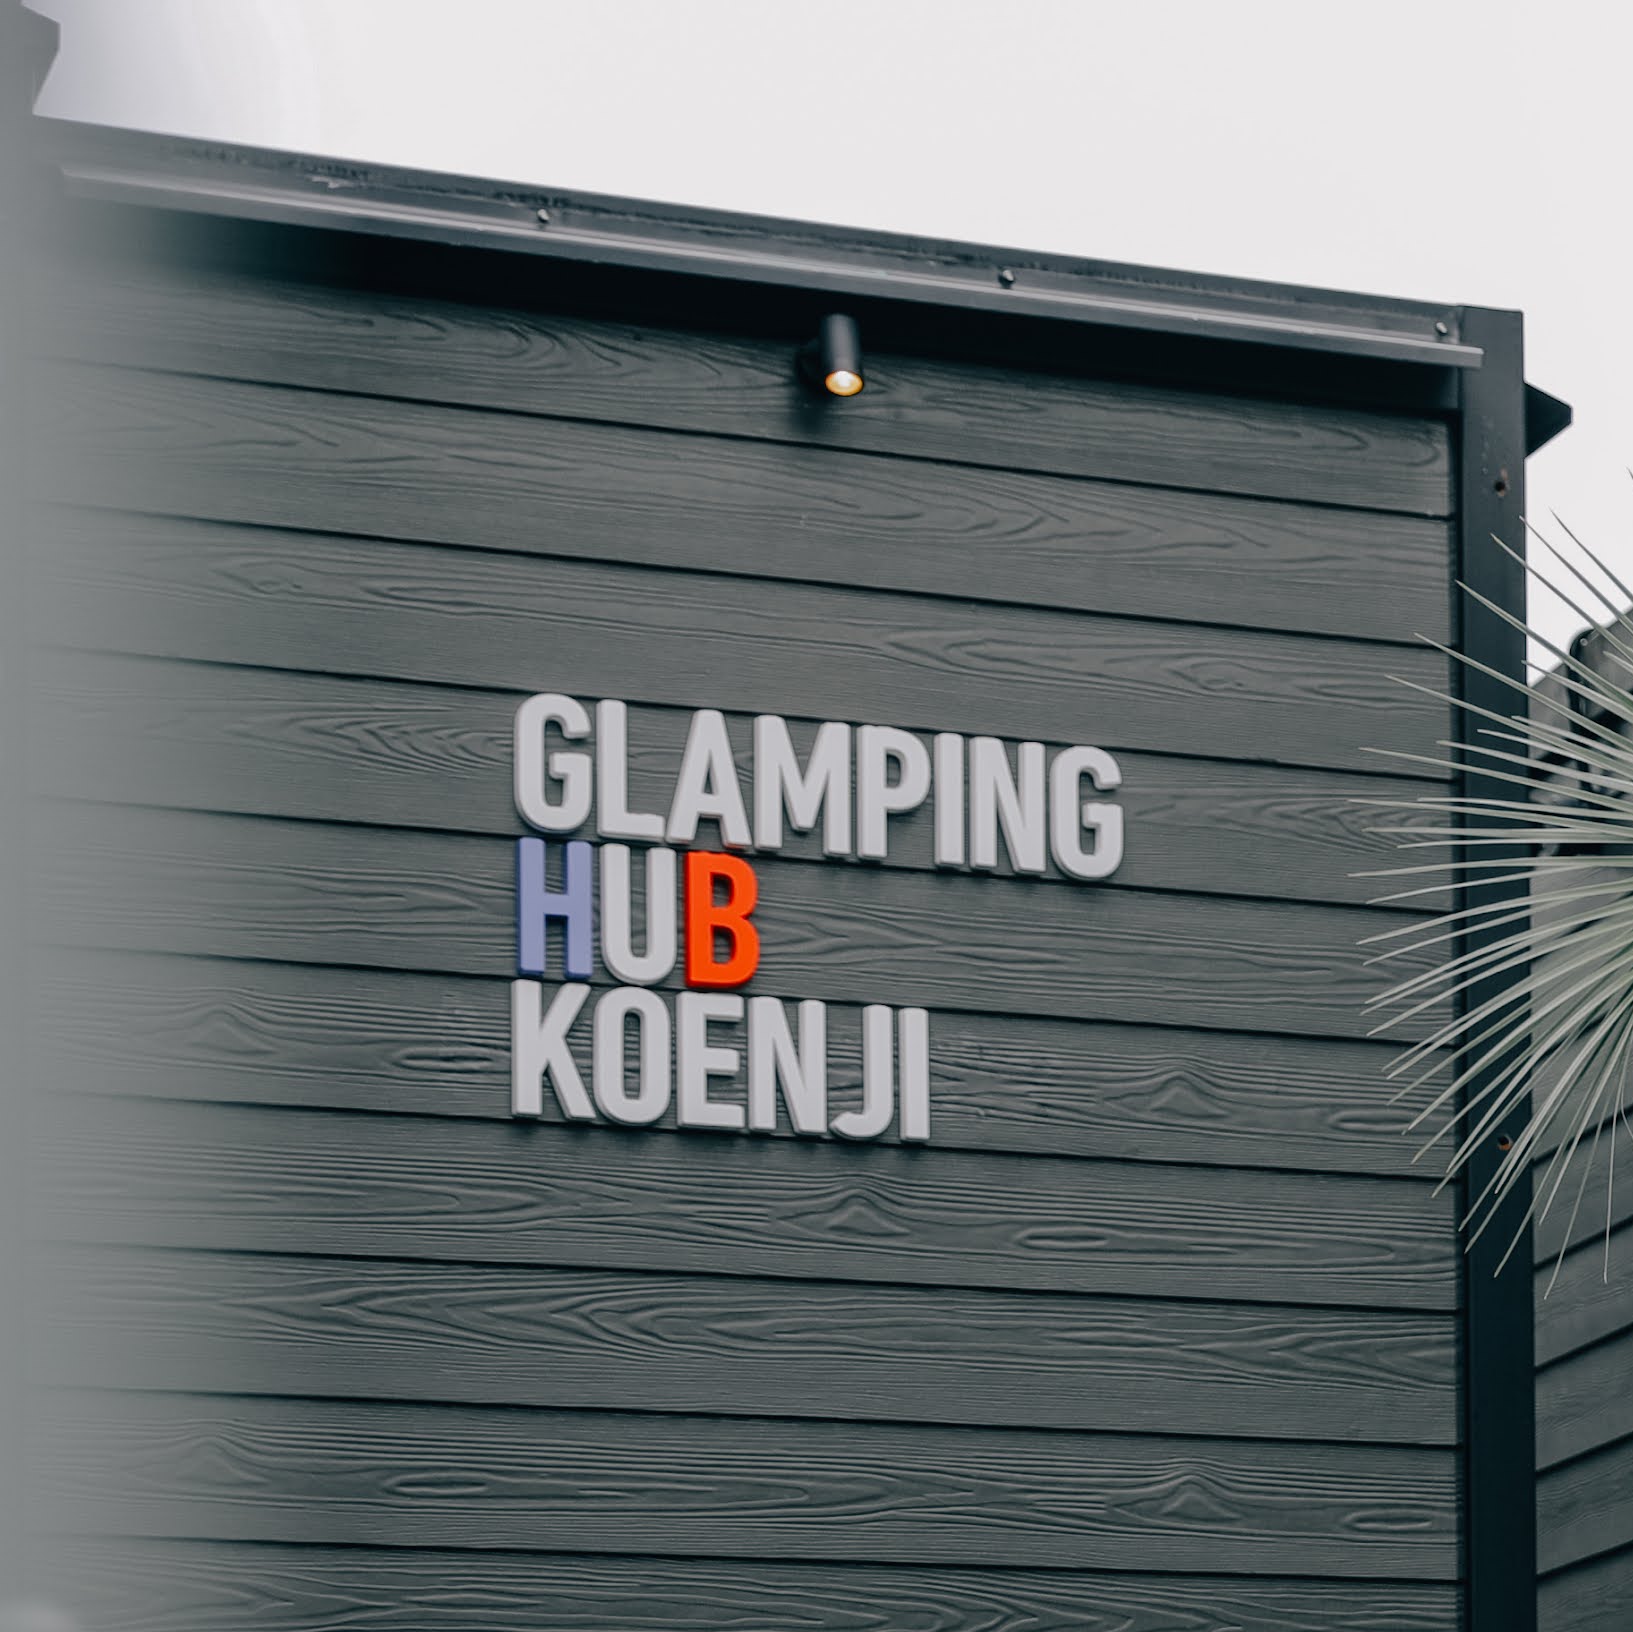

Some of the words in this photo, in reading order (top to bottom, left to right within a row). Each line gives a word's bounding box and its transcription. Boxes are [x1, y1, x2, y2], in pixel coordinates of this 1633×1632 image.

[512, 692, 1125, 880] GLAMPING
[515, 836, 760, 989] HUB
[510, 978, 931, 1143] KOENJI
